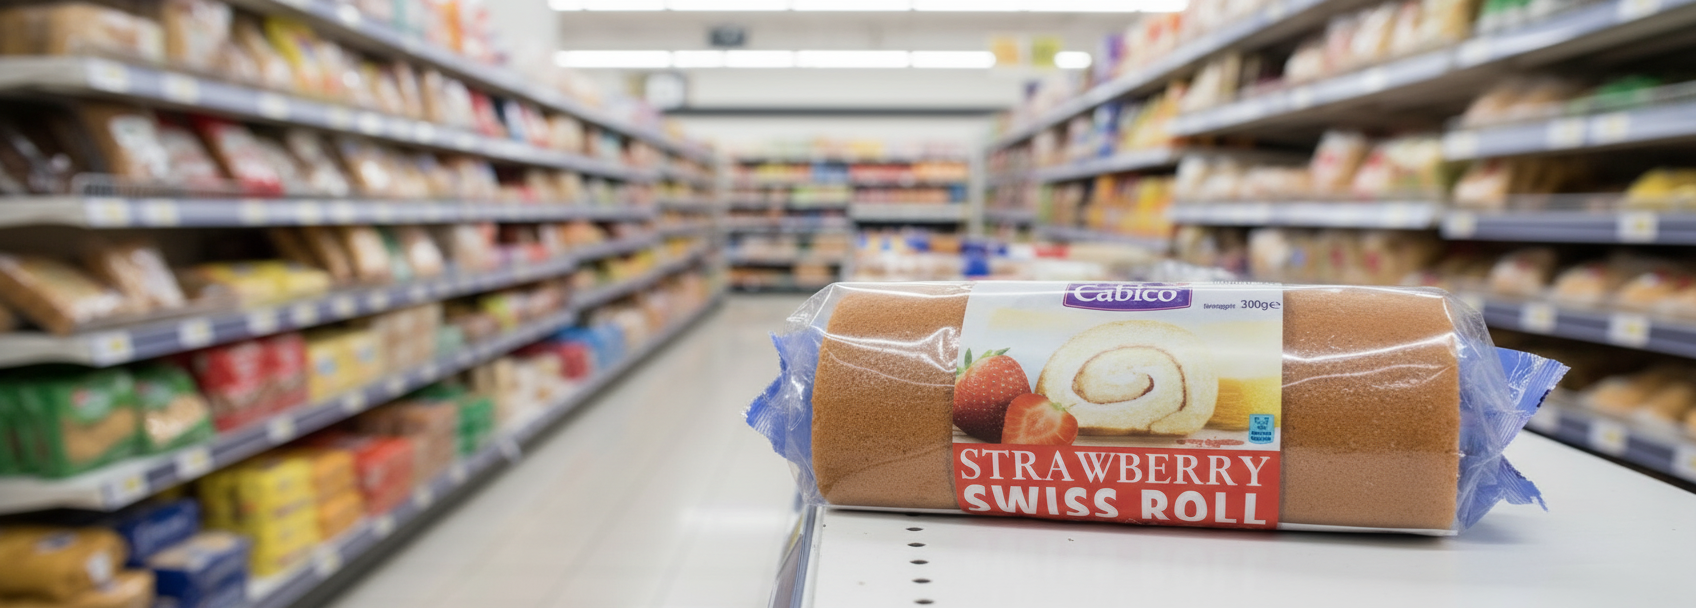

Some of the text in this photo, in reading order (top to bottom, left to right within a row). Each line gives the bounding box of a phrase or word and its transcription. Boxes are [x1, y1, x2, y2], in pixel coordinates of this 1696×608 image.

[1073, 285, 1178, 302] Cabico
[959, 448, 1271, 487] STRAWBERRY
[963, 484, 1267, 525] SWISS ROLL
